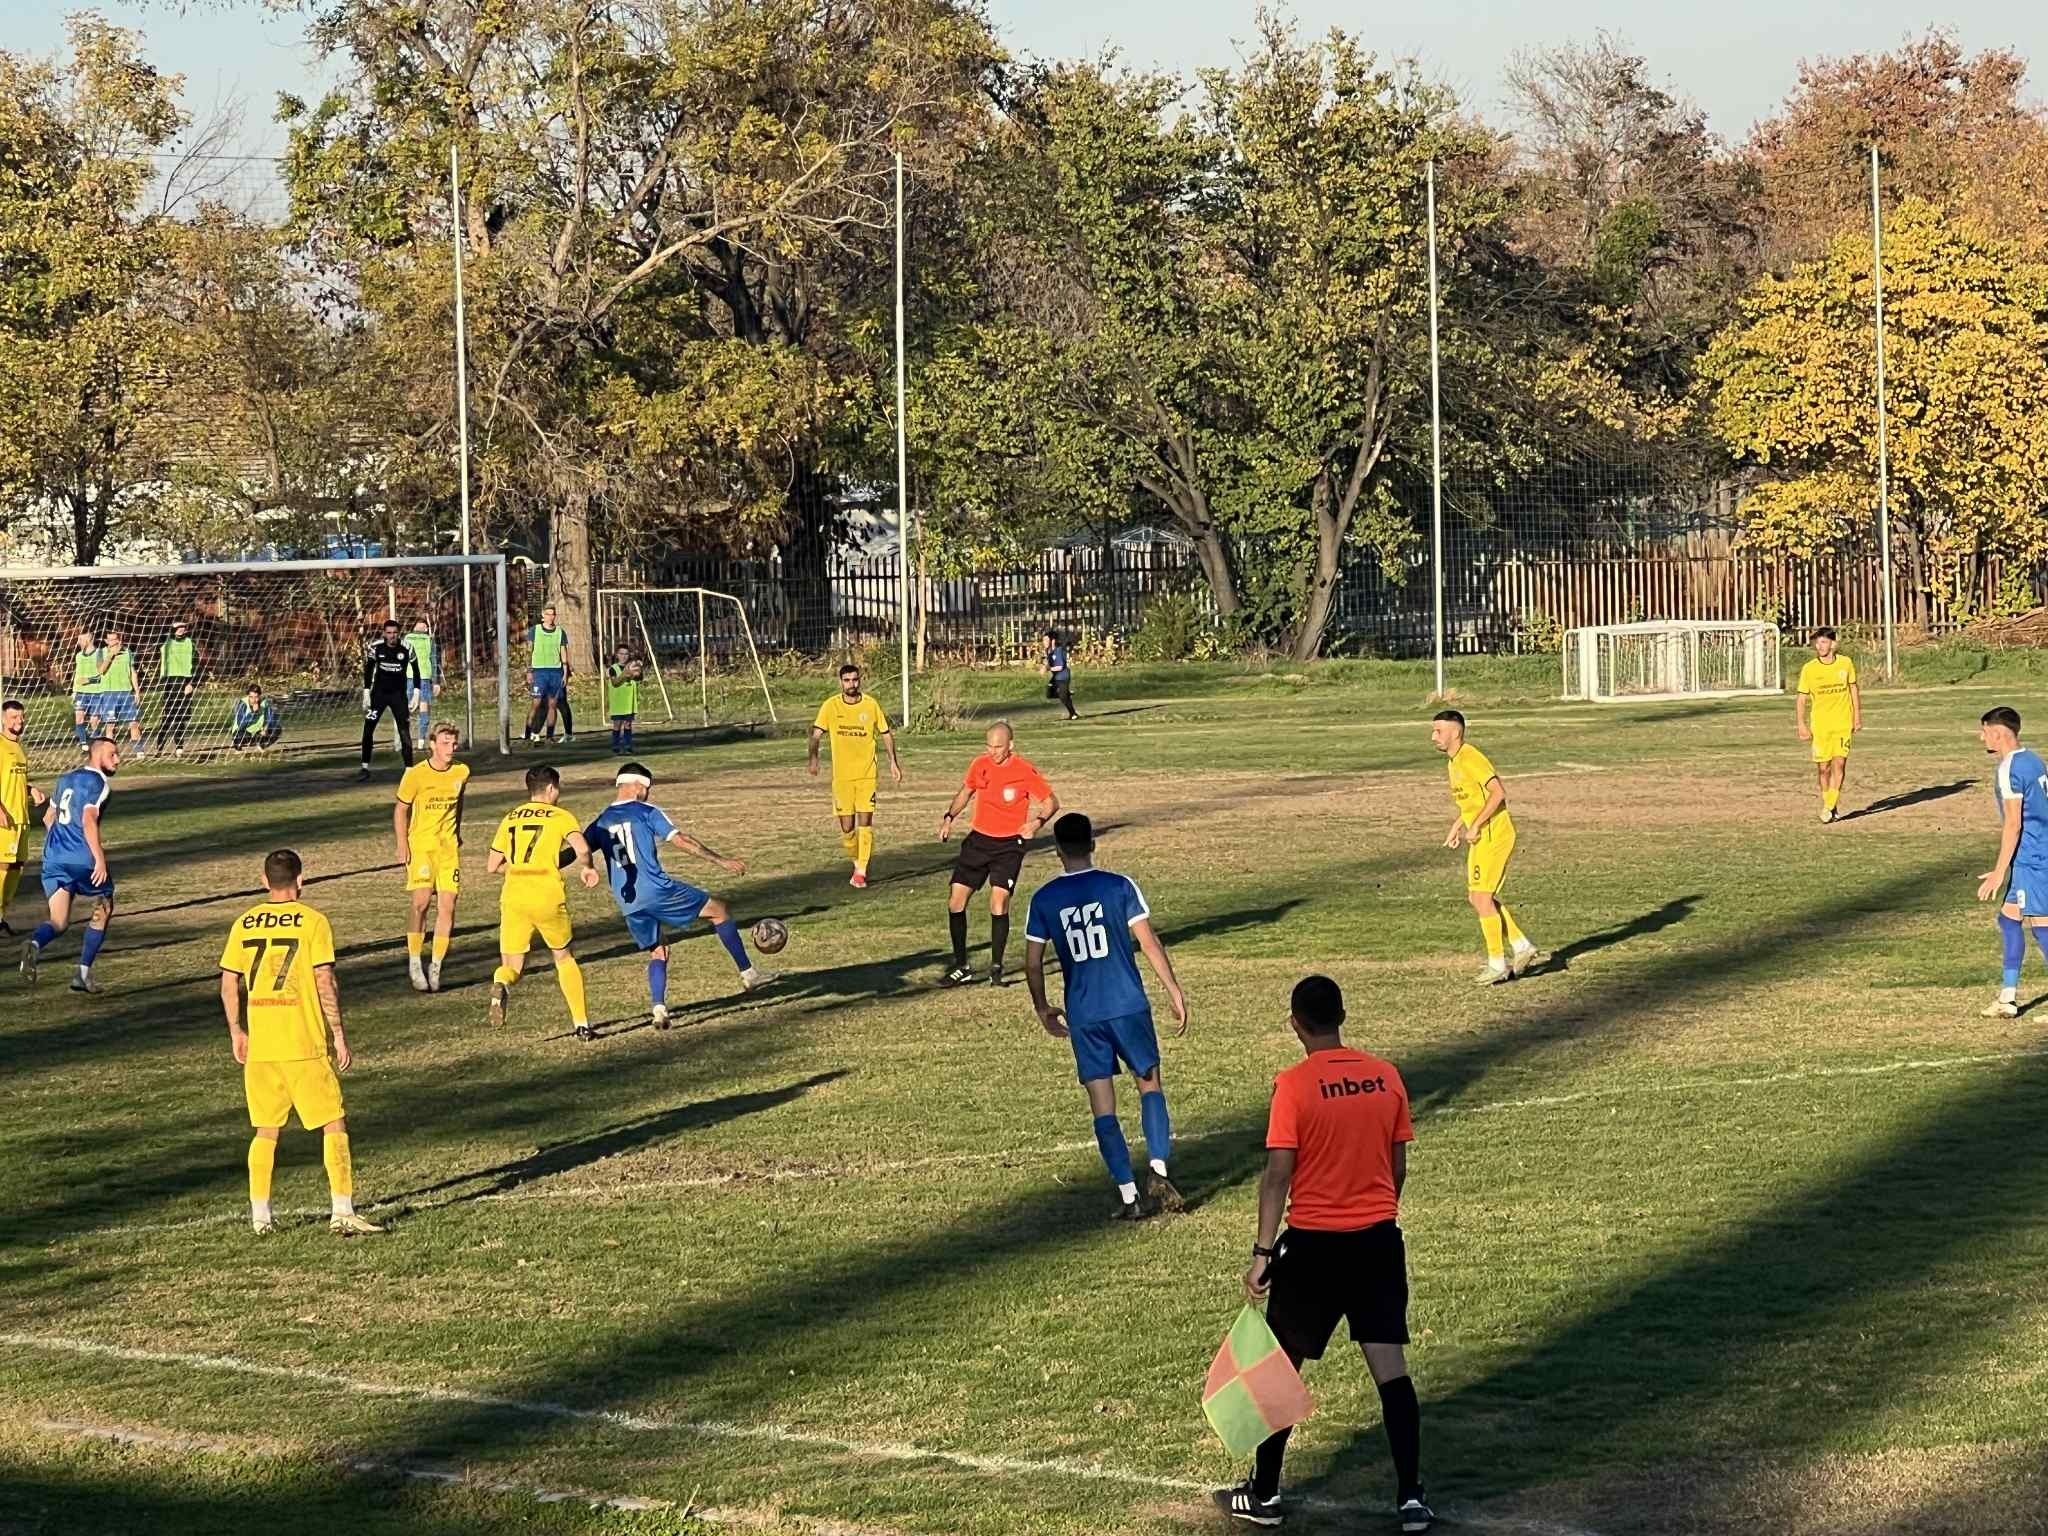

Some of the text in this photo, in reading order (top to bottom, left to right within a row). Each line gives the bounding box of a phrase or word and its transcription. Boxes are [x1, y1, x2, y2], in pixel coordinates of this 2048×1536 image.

[508, 824, 544, 865] 17
[243, 912, 304, 929] efbet
[1059, 901, 1109, 963] 66
[242, 938, 299, 992] 77
[1319, 1076, 1386, 1099] inbet
